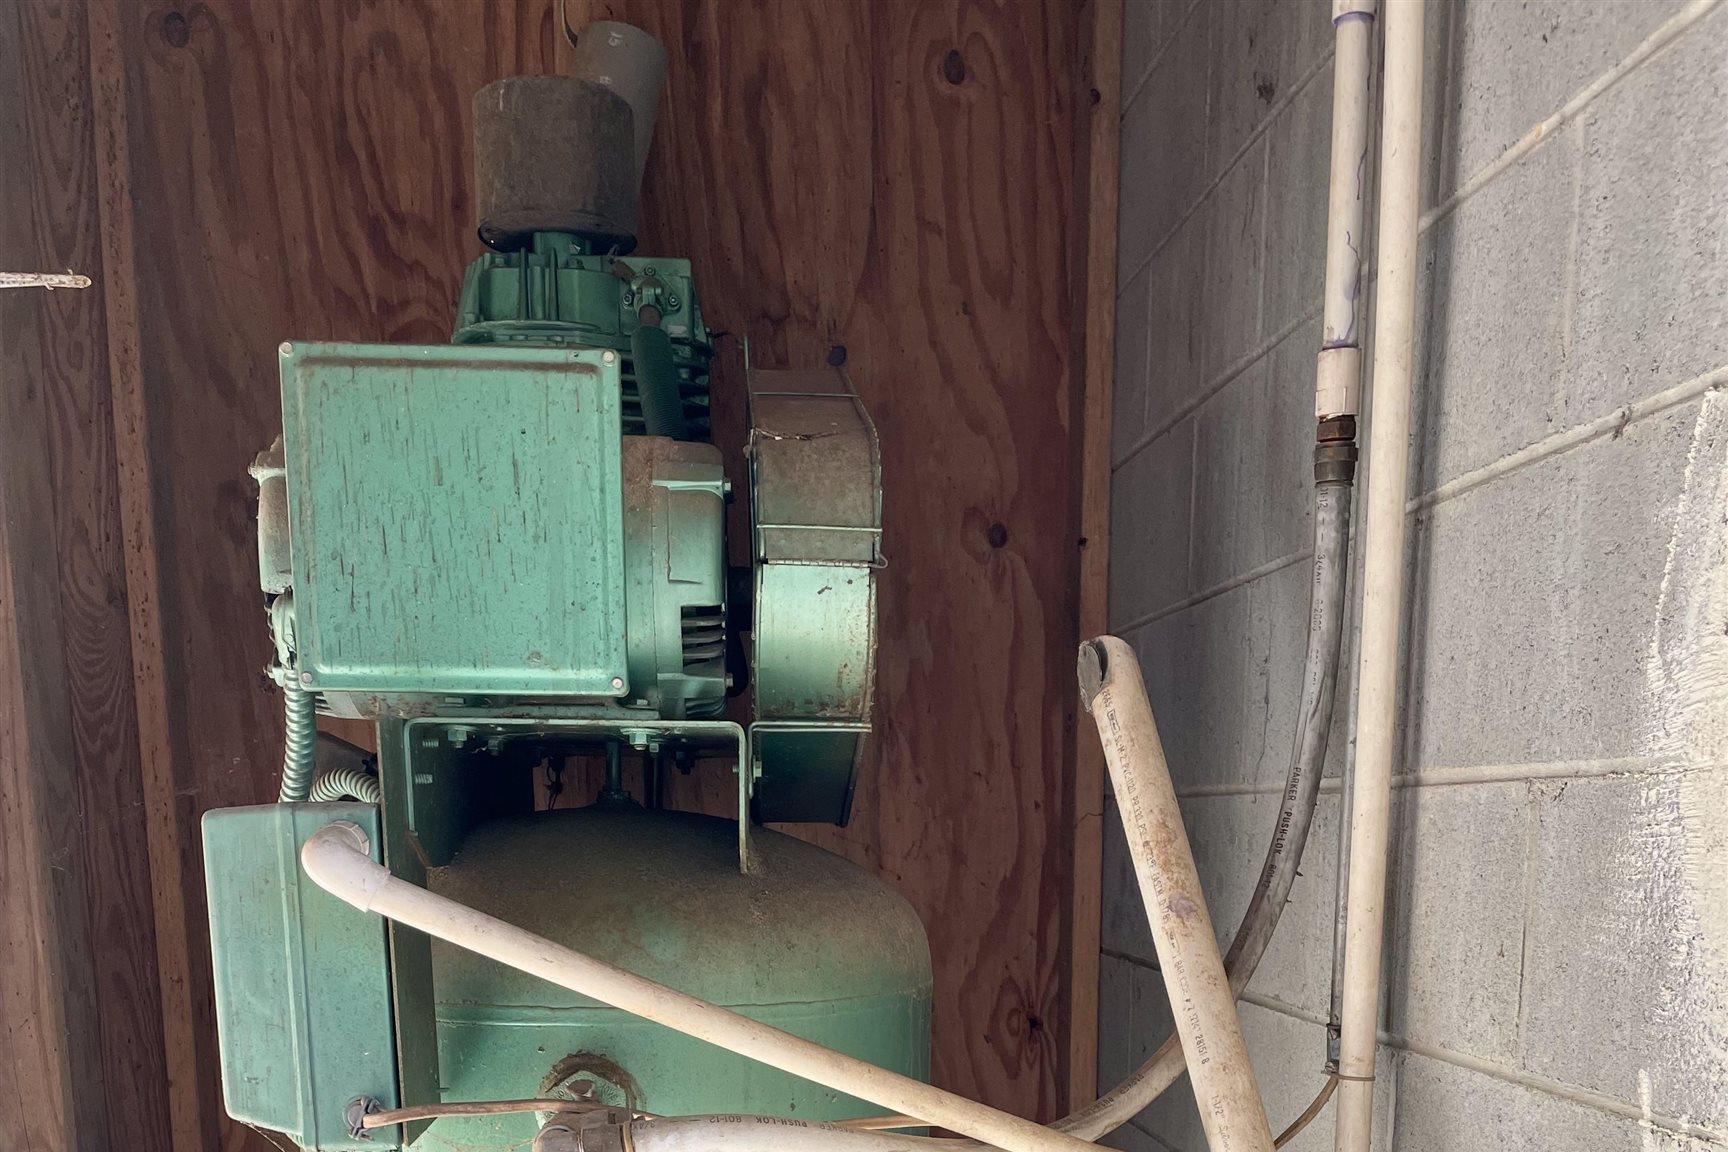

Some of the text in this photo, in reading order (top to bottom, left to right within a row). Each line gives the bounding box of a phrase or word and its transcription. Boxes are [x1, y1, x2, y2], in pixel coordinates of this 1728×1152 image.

[1283, 765, 1303, 802] PARKER
[1271, 809, 1293, 855] PUSH-LOK
[709, 1114, 741, 1123] 801-12
[754, 1115, 808, 1127] PUSH-LOK
